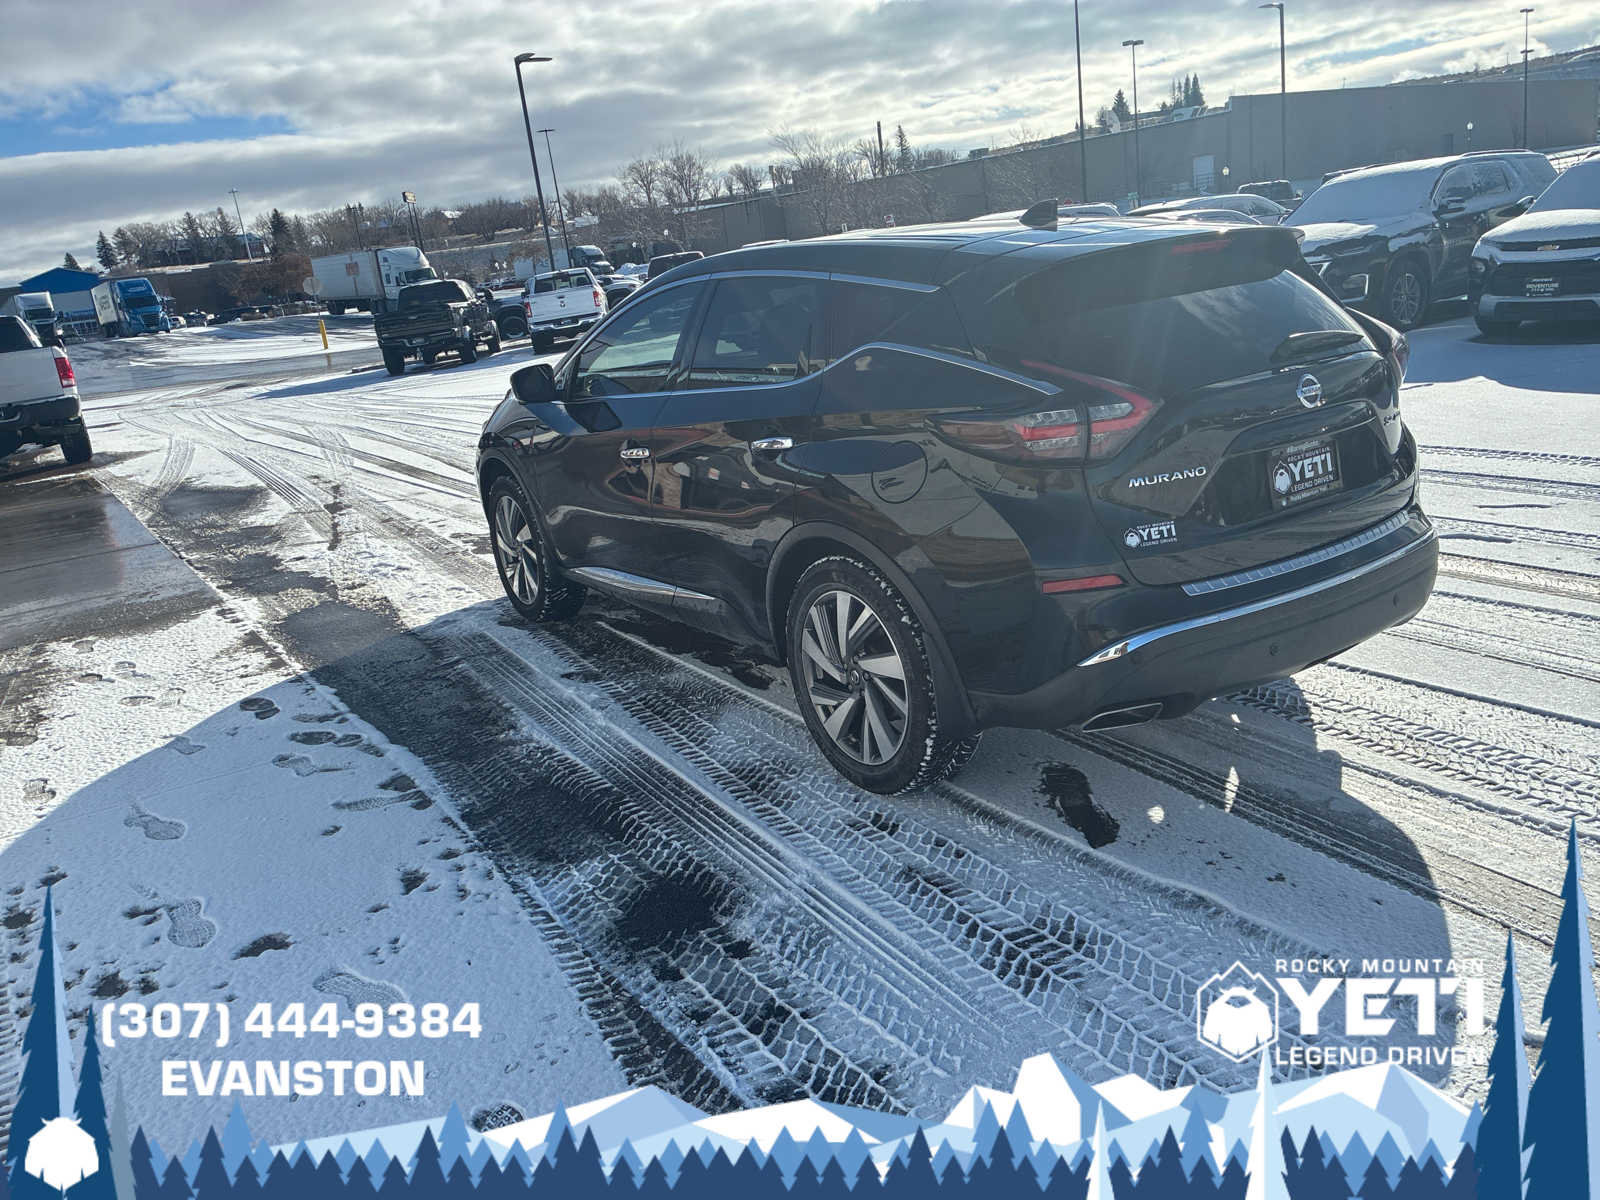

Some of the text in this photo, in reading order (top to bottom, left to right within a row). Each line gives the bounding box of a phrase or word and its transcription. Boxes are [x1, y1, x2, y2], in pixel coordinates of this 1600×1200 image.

[1128, 466, 1207, 488] MURANO
[1289, 452, 1333, 481] YETI
[1138, 524, 1176, 541] YETI
